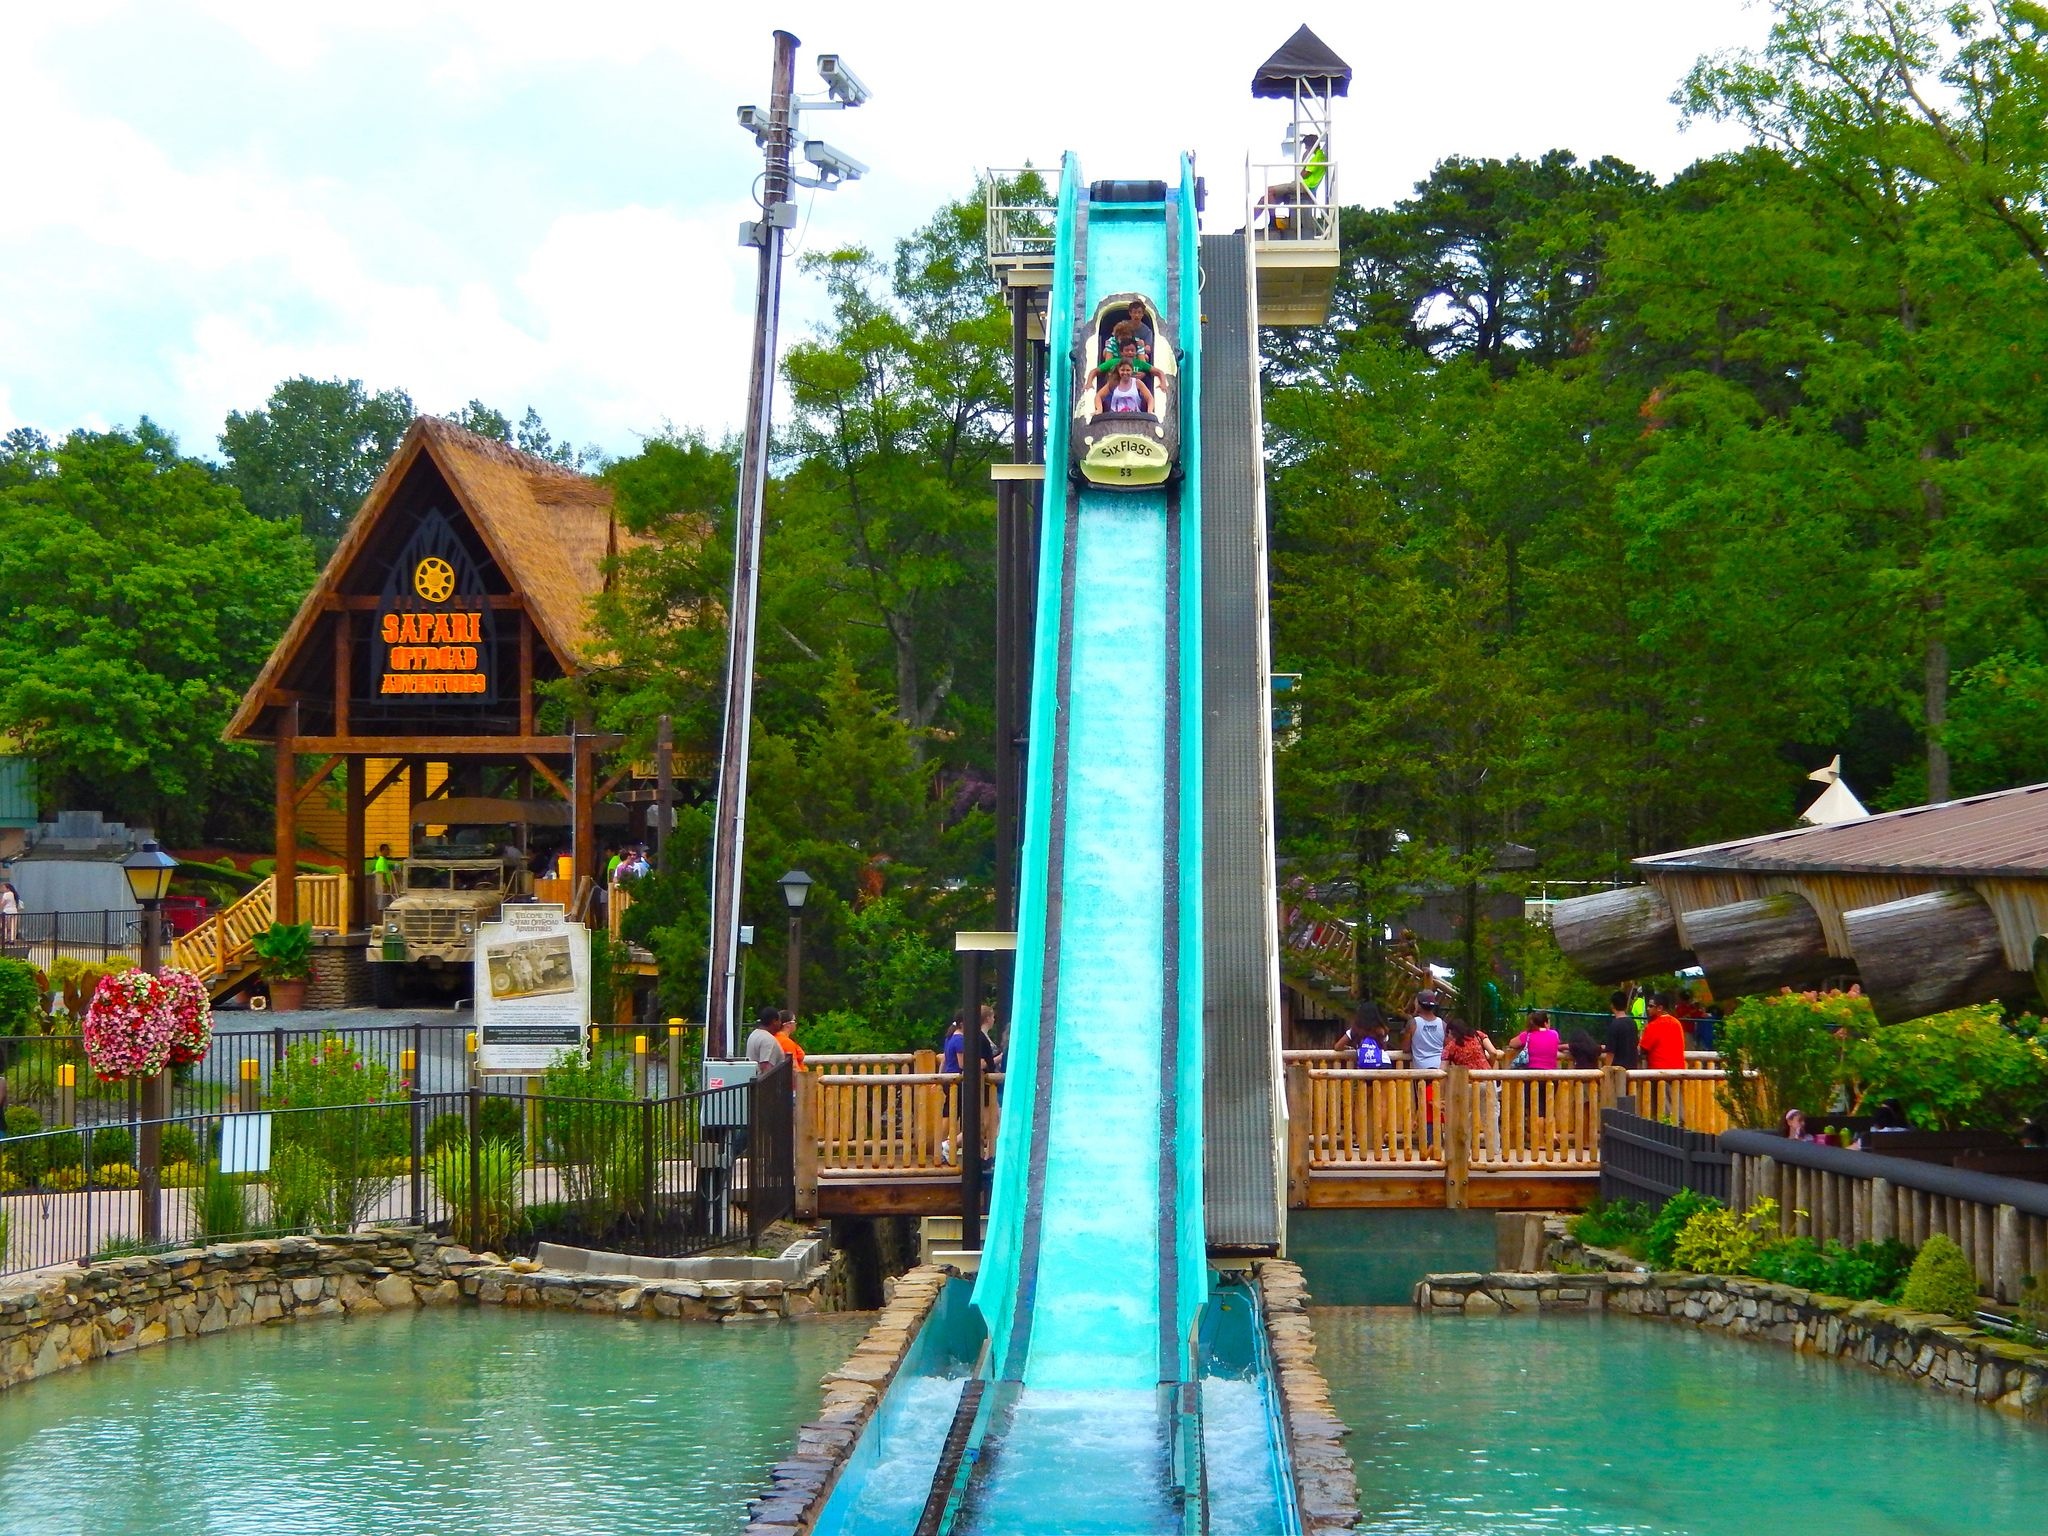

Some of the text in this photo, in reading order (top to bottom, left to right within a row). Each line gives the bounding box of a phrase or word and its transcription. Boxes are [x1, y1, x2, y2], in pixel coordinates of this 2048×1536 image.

[1120, 468, 1132, 477] 53
[381, 613, 482, 643] SAFARI
[390, 646, 478, 670] OFFROAD
[381, 673, 487, 693] ADVENTURES
